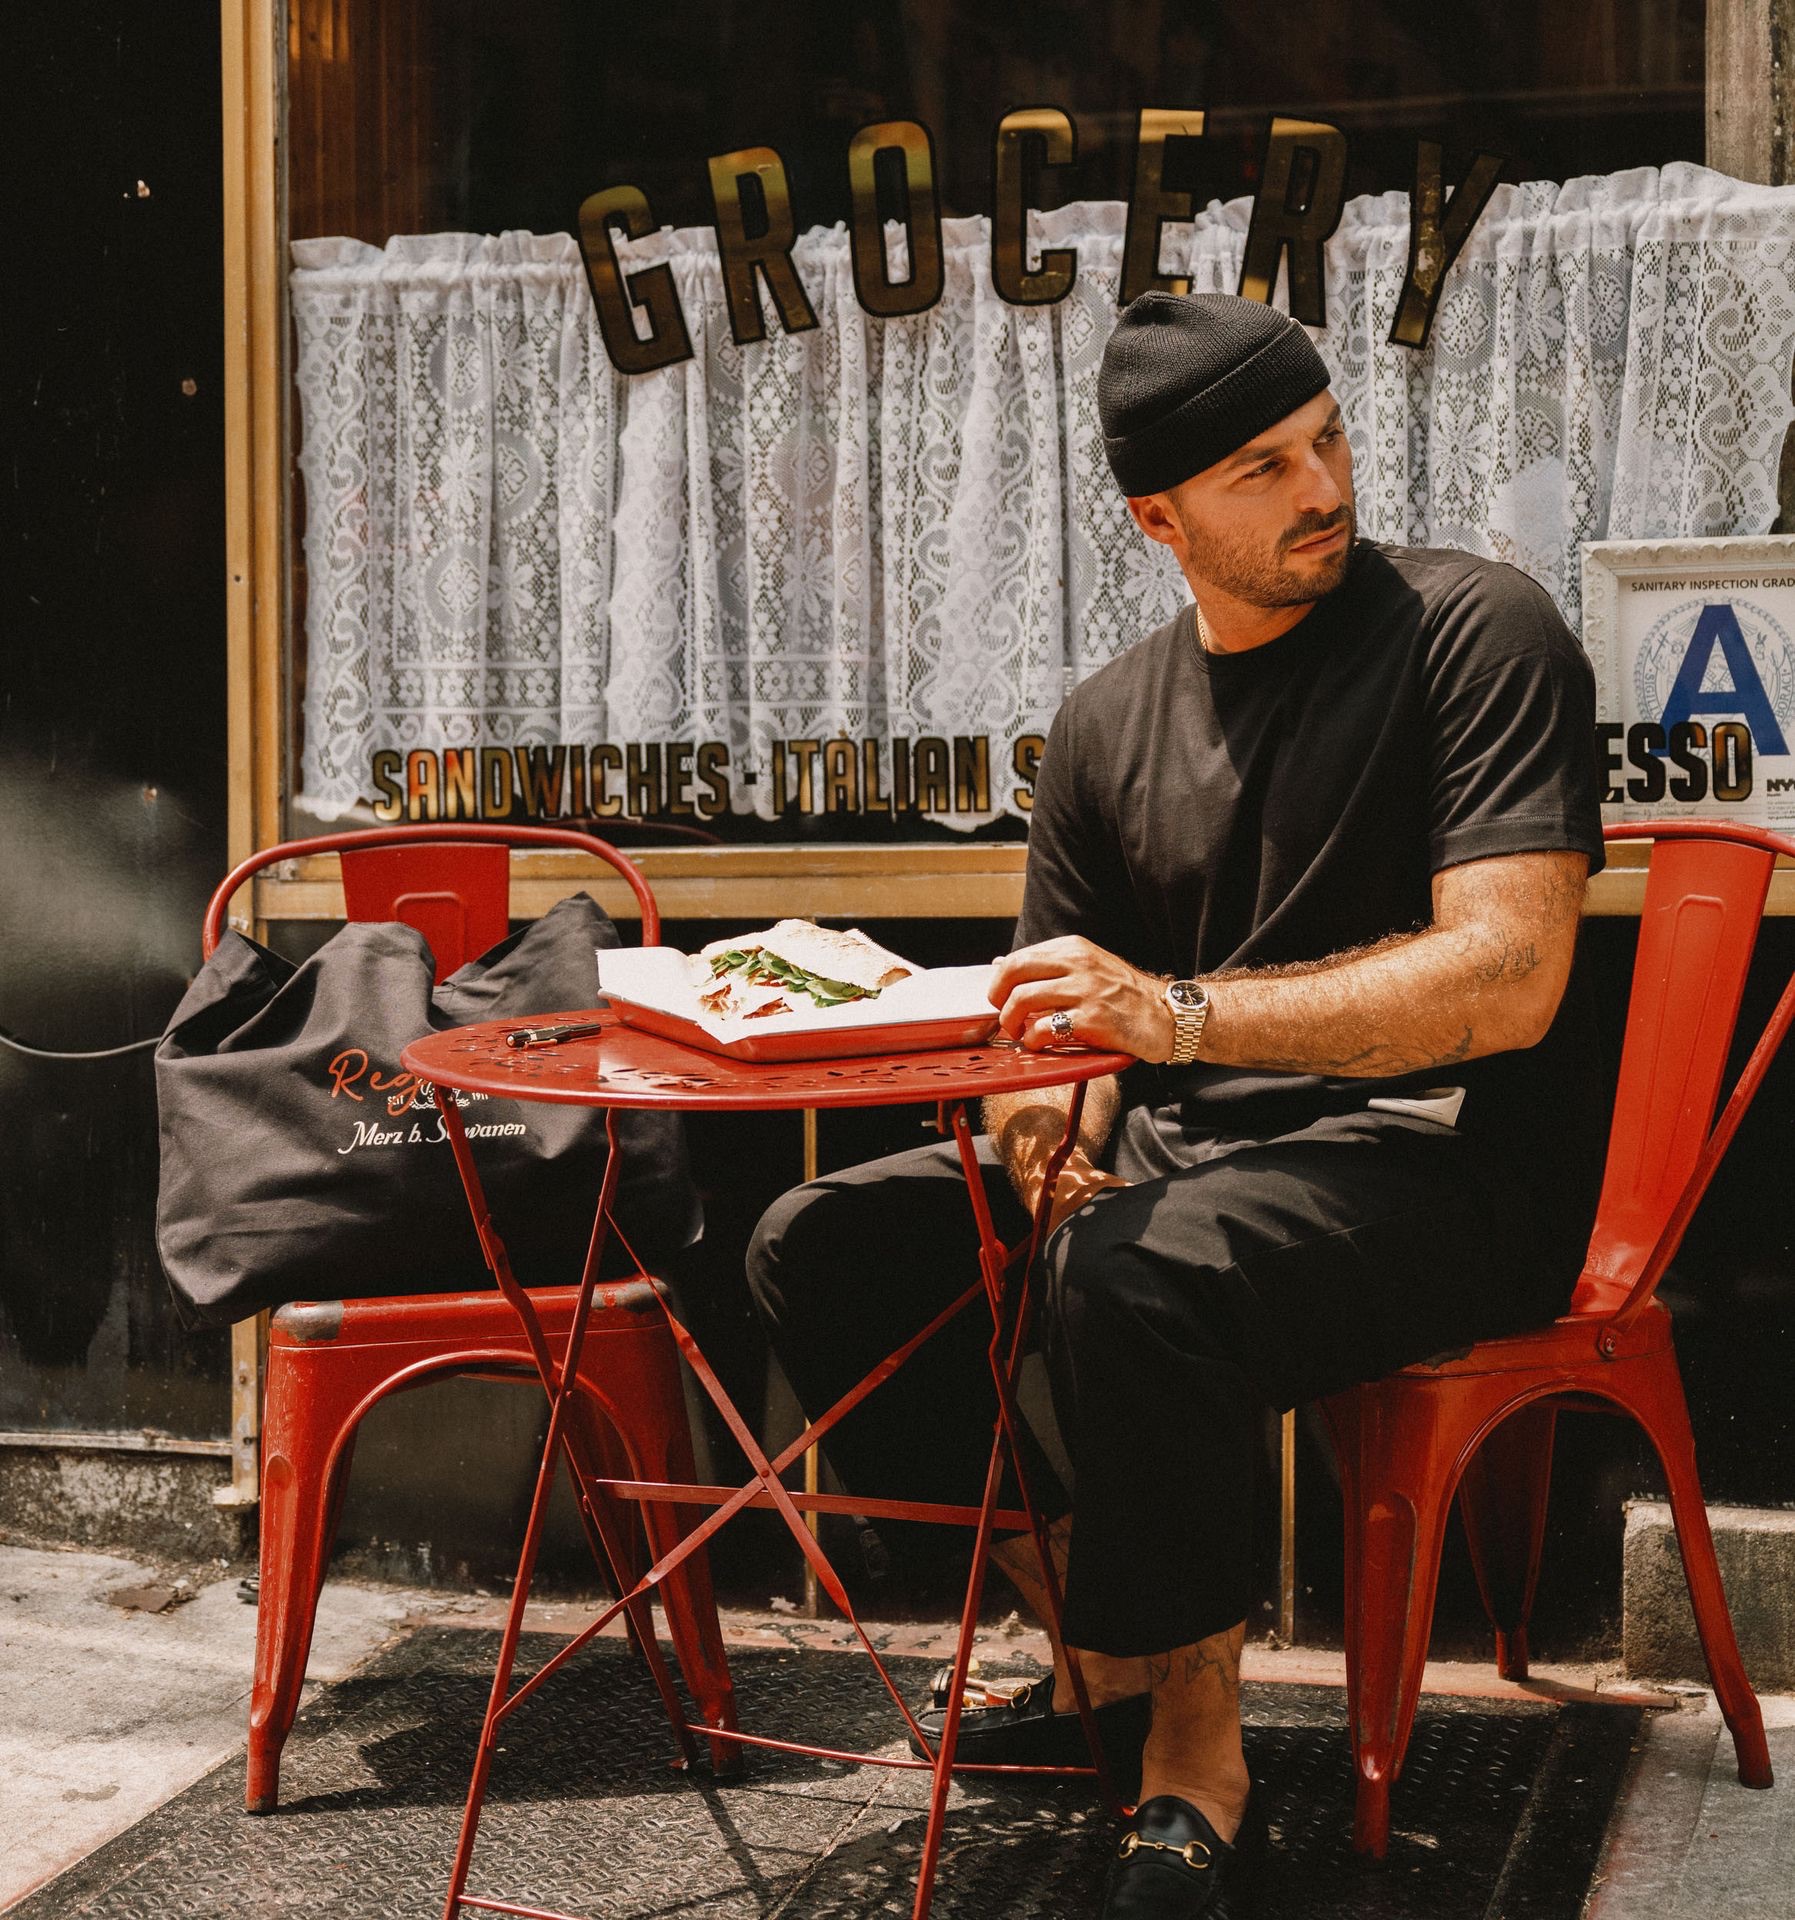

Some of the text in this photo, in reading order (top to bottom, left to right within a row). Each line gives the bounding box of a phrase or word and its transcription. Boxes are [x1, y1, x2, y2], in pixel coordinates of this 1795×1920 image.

[577, 105, 1508, 376] GROCERY
[1631, 580, 1686, 592] SANITARY
[1690, 578, 1758, 591] INSPECTION
[1644, 672, 1661, 721] SIGILL
[1650, 604, 1790, 757] A
[371, 739, 729, 822] SANDWICHES
[772, 734, 992, 817] ITALIAN
[1766, 778, 1795, 792] NY
[337, 1121, 404, 1155] Merz
[408, 1122, 422, 1144] b.
